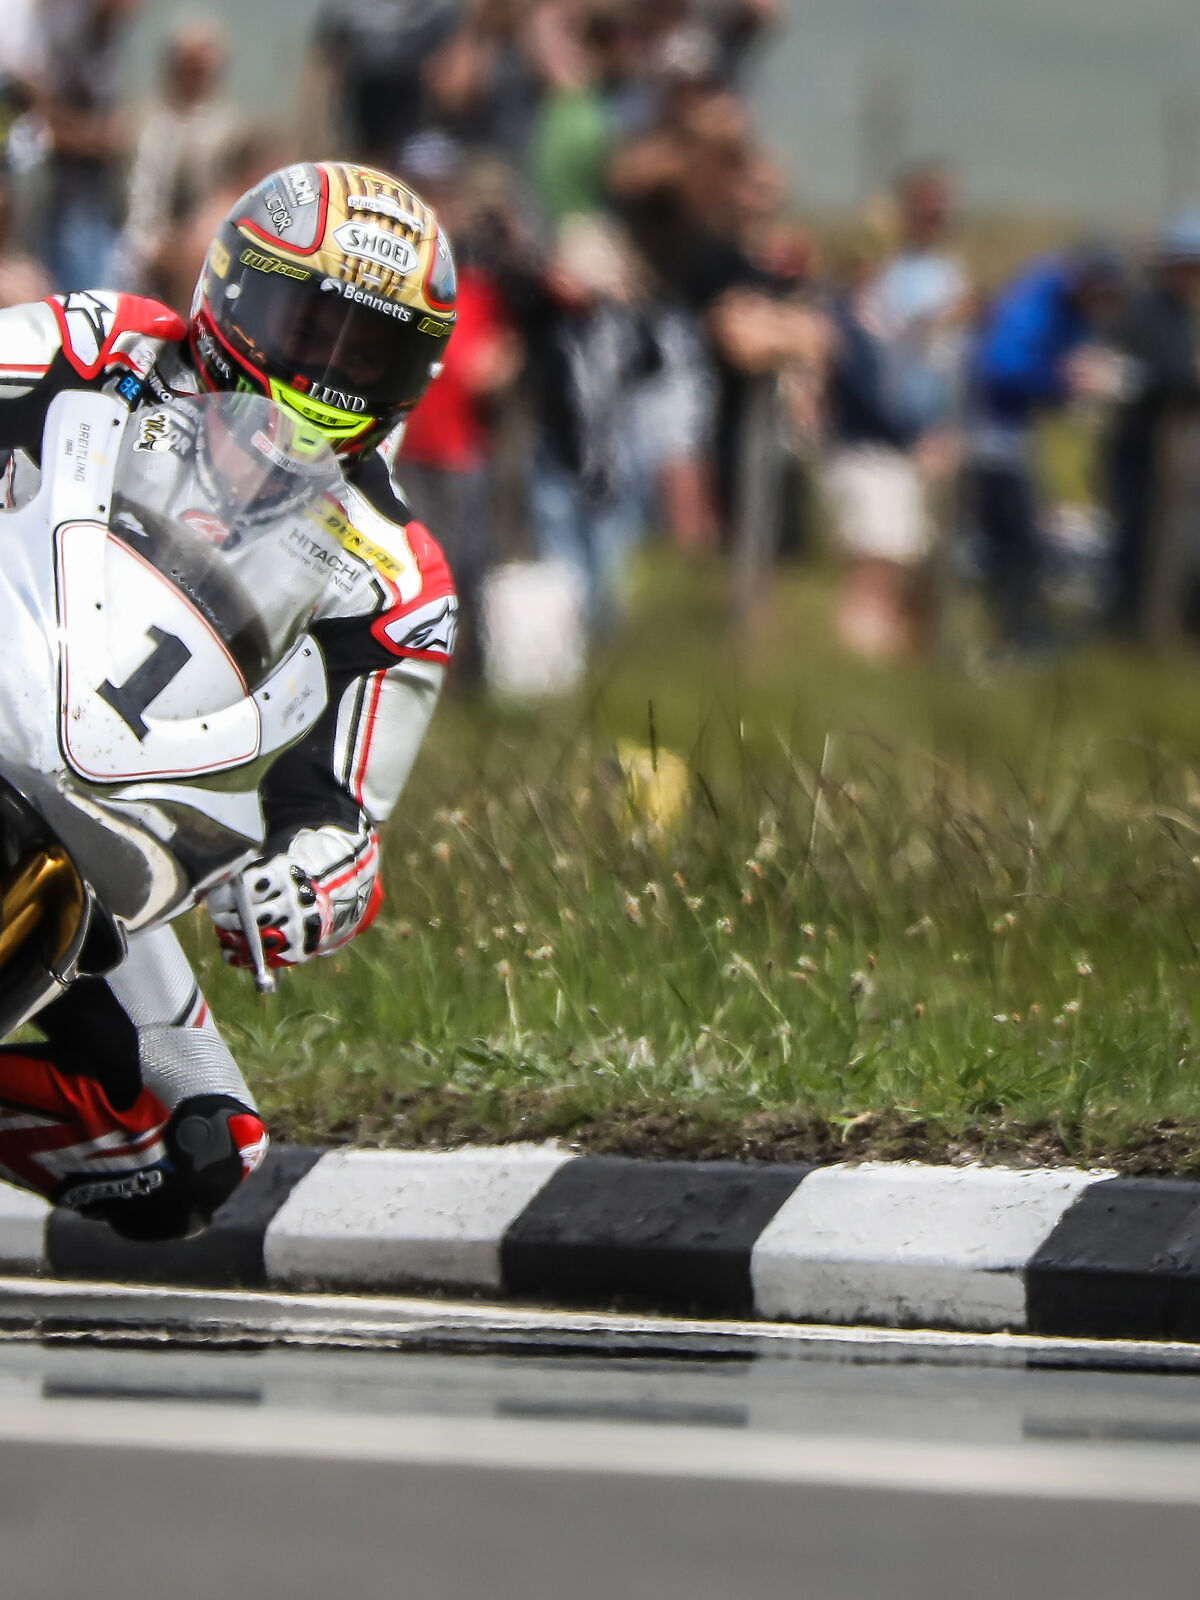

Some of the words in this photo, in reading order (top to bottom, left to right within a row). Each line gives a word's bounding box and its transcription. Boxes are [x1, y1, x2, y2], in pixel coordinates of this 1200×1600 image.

[347, 228, 409, 268] SHOEI
[343, 285, 412, 323] Bennetts
[308, 381, 367, 413] LUND
[74, 422, 91, 483] BREITLING
[288, 527, 361, 584] HITACHI
[94, 623, 193, 743] 1
